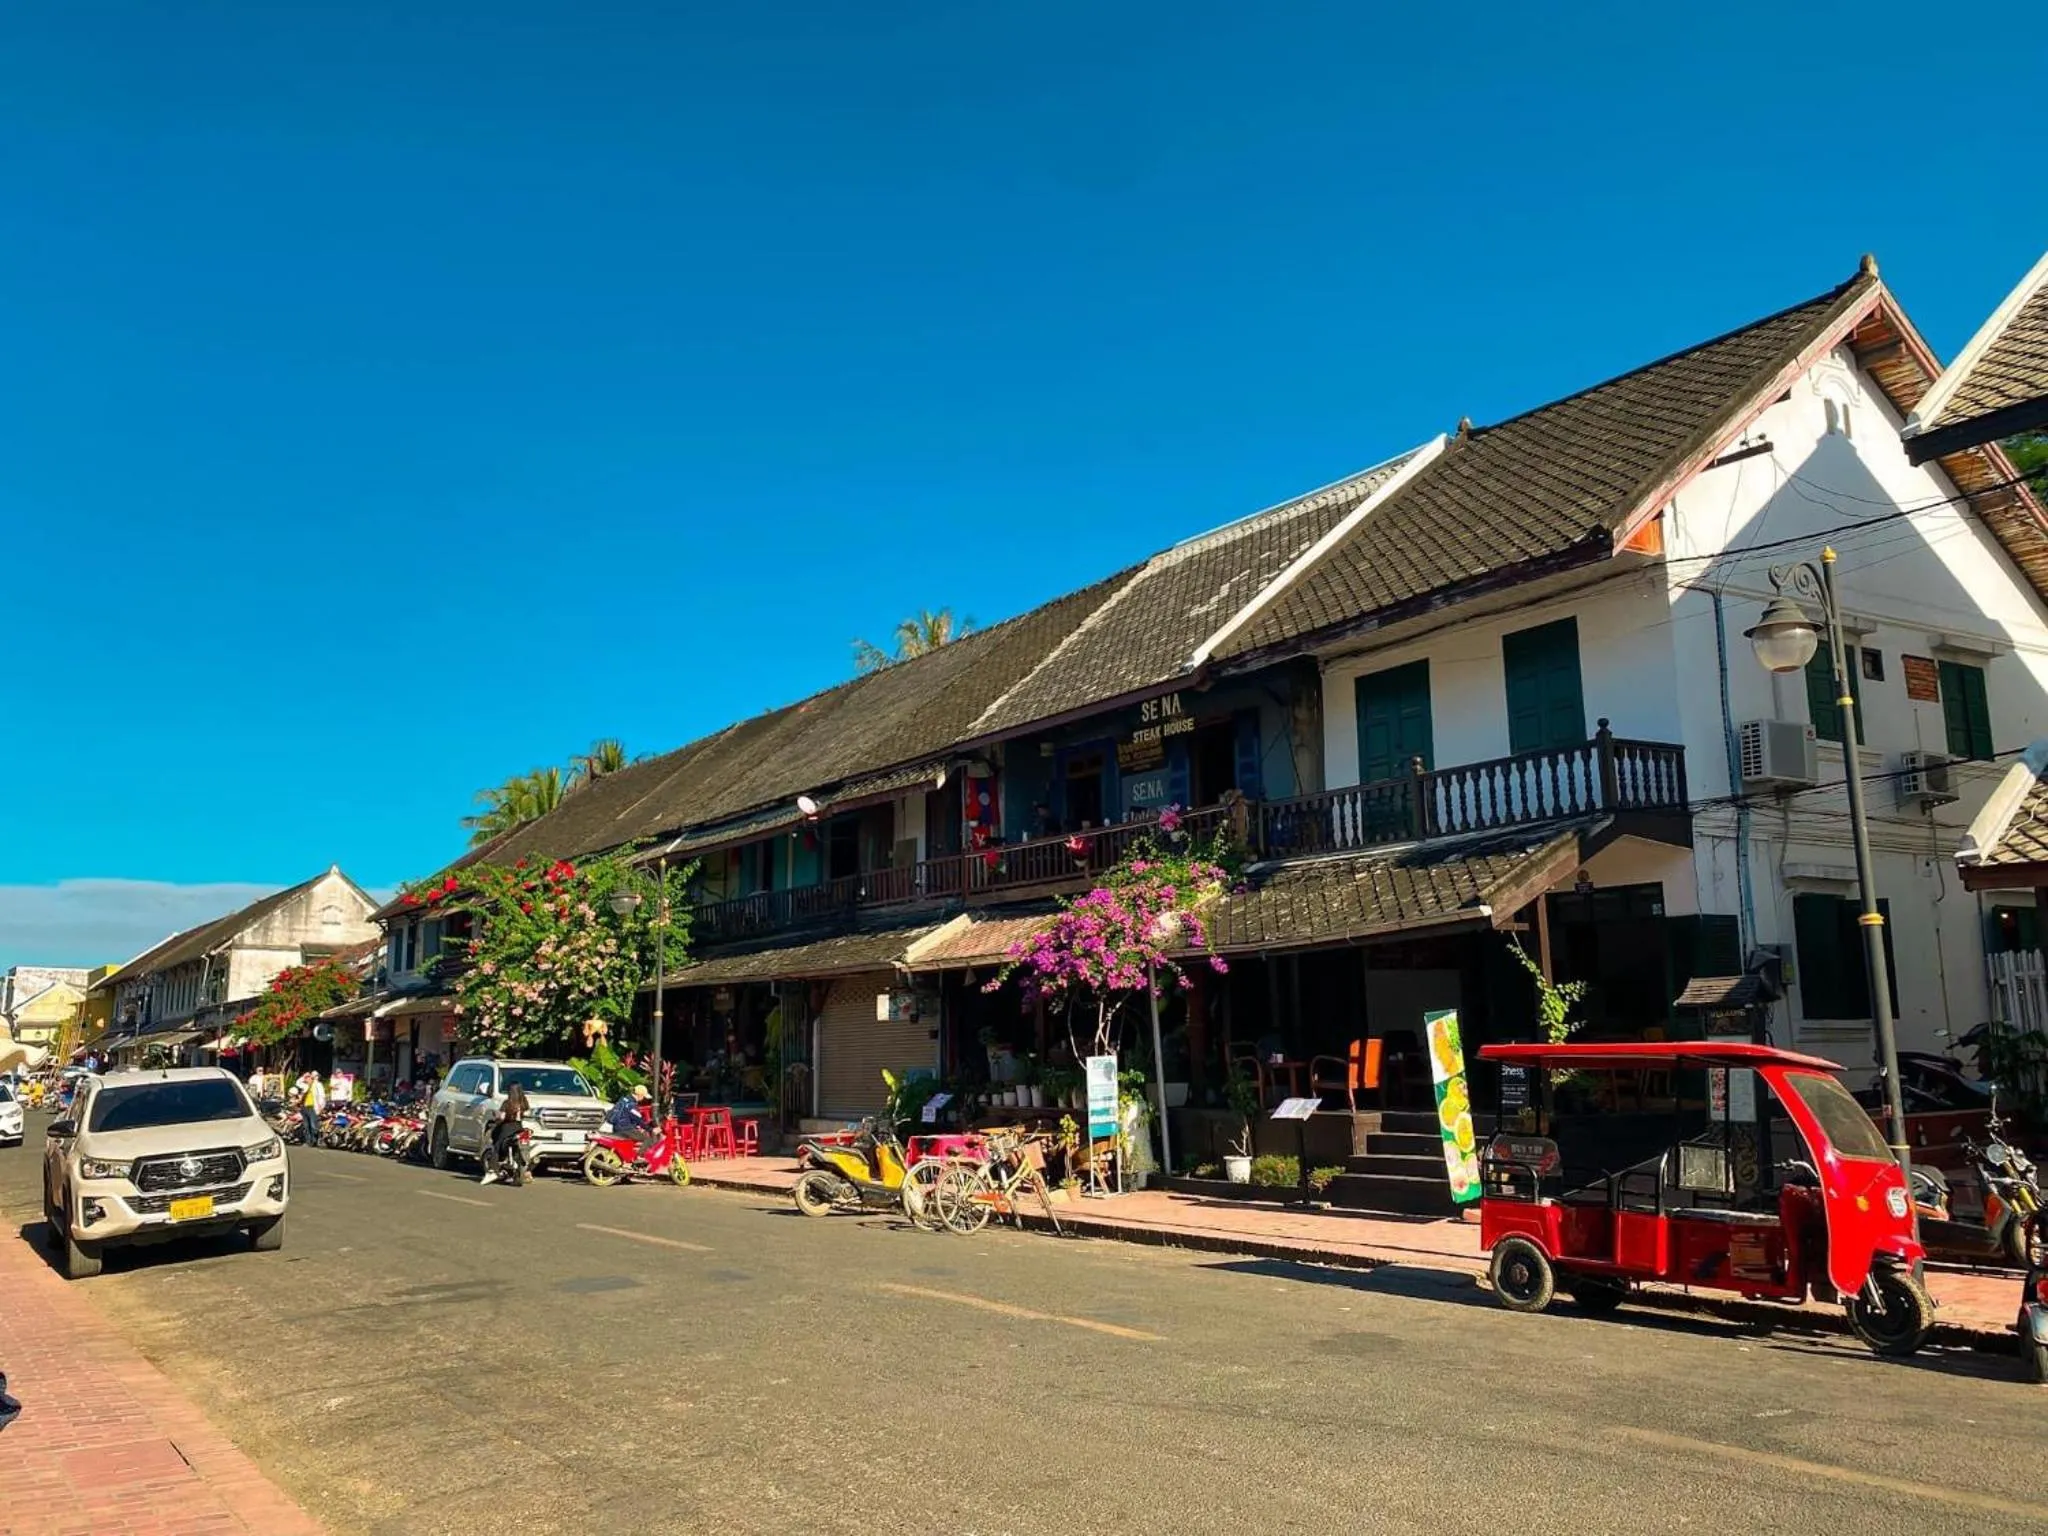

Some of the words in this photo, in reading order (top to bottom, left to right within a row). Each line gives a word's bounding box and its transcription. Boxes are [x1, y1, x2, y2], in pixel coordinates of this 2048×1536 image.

[1133, 725, 1161, 744] STEAK
[1163, 717, 1195, 737] HOUSE
[1132, 779, 1164, 801] SENA
